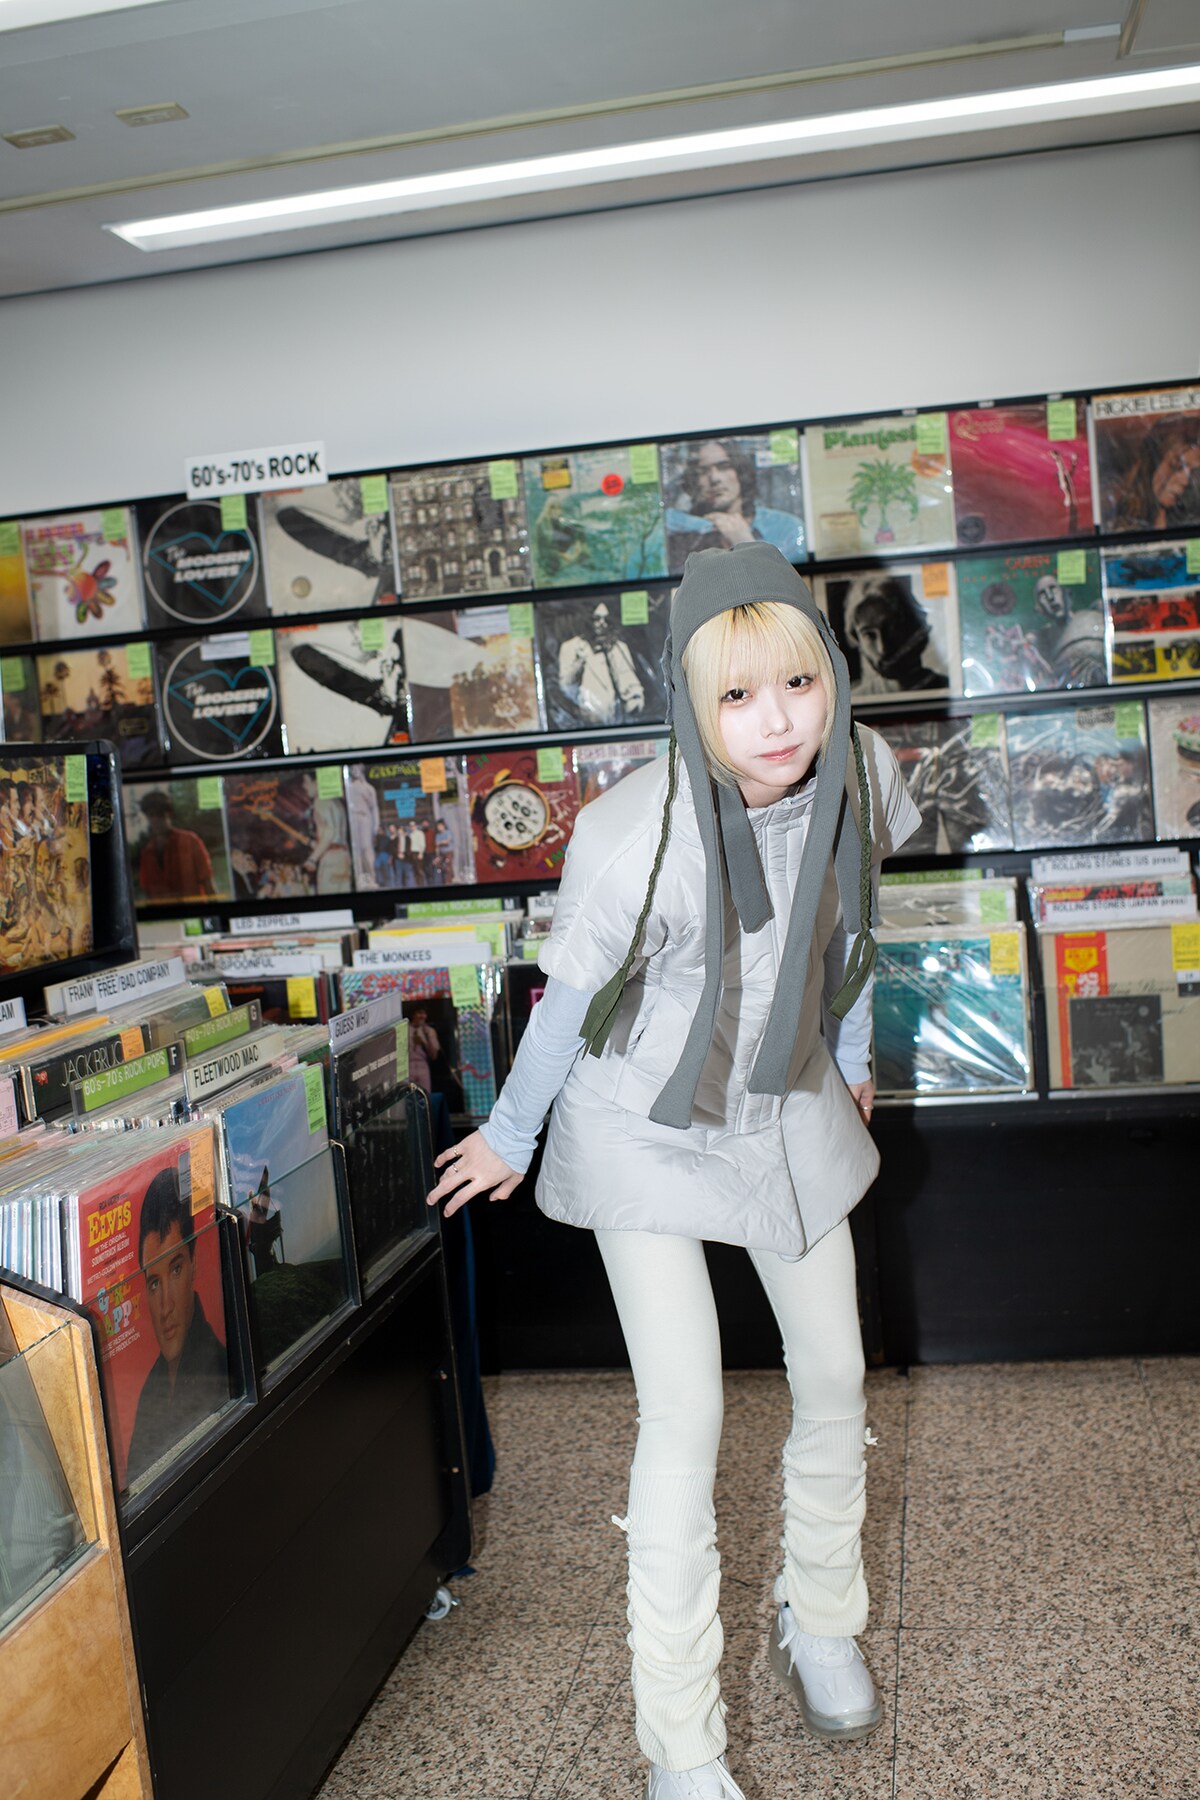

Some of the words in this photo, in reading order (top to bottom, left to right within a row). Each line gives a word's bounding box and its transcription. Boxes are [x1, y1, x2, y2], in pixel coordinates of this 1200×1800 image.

[1095, 396, 1147, 417] RICKIE
[1150, 391, 1181, 411] LEE
[191, 460, 265, 488] 60's-70's
[269, 451, 321, 478] ROCK
[175, 549, 252, 569] MODERN
[1005, 555, 1051, 570] QUEEN
[173, 564, 241, 583] LOVERS
[194, 687, 270, 706] MODERN
[192, 701, 260, 720] LOVERS
[1051, 858, 1093, 871] ROLLING
[1095, 856, 1131, 868] STONES
[504, 898, 515, 910] M
[1051, 901, 1091, 913] ROLLING
[1093, 899, 1127, 911] STONES
[204, 918, 214, 930] K
[235, 918, 254, 930] LED
[256, 915, 301, 929] ZEPPELIN
[220, 957, 275, 972] SPOONFUL
[359, 952, 379, 965] THE
[381, 949, 432, 964] MONKEES
[138, 962, 171, 987] COMPANY
[0, 1001, 16, 1021] AM
[250, 1004, 258, 1021] G
[335, 1014, 355, 1038] GUESS
[356, 1008, 370, 1029] WHO
[170, 1046, 177, 1066] F
[62, 1051, 94, 1087] JACK
[193, 1052, 241, 1089] FLEETWOOD
[241, 1044, 260, 1068] MAC
[87, 1200, 132, 1248] ELVIS
[91, 1245, 117, 1268] SOUNDTRACK
[116, 1237, 130, 1252] ALBUM
[94, 1246, 101, 1255] IN
[100, 1240, 109, 1250] THE
[109, 1231, 127, 1246] ORIGINAL
[100, 1292, 142, 1337] APPY
